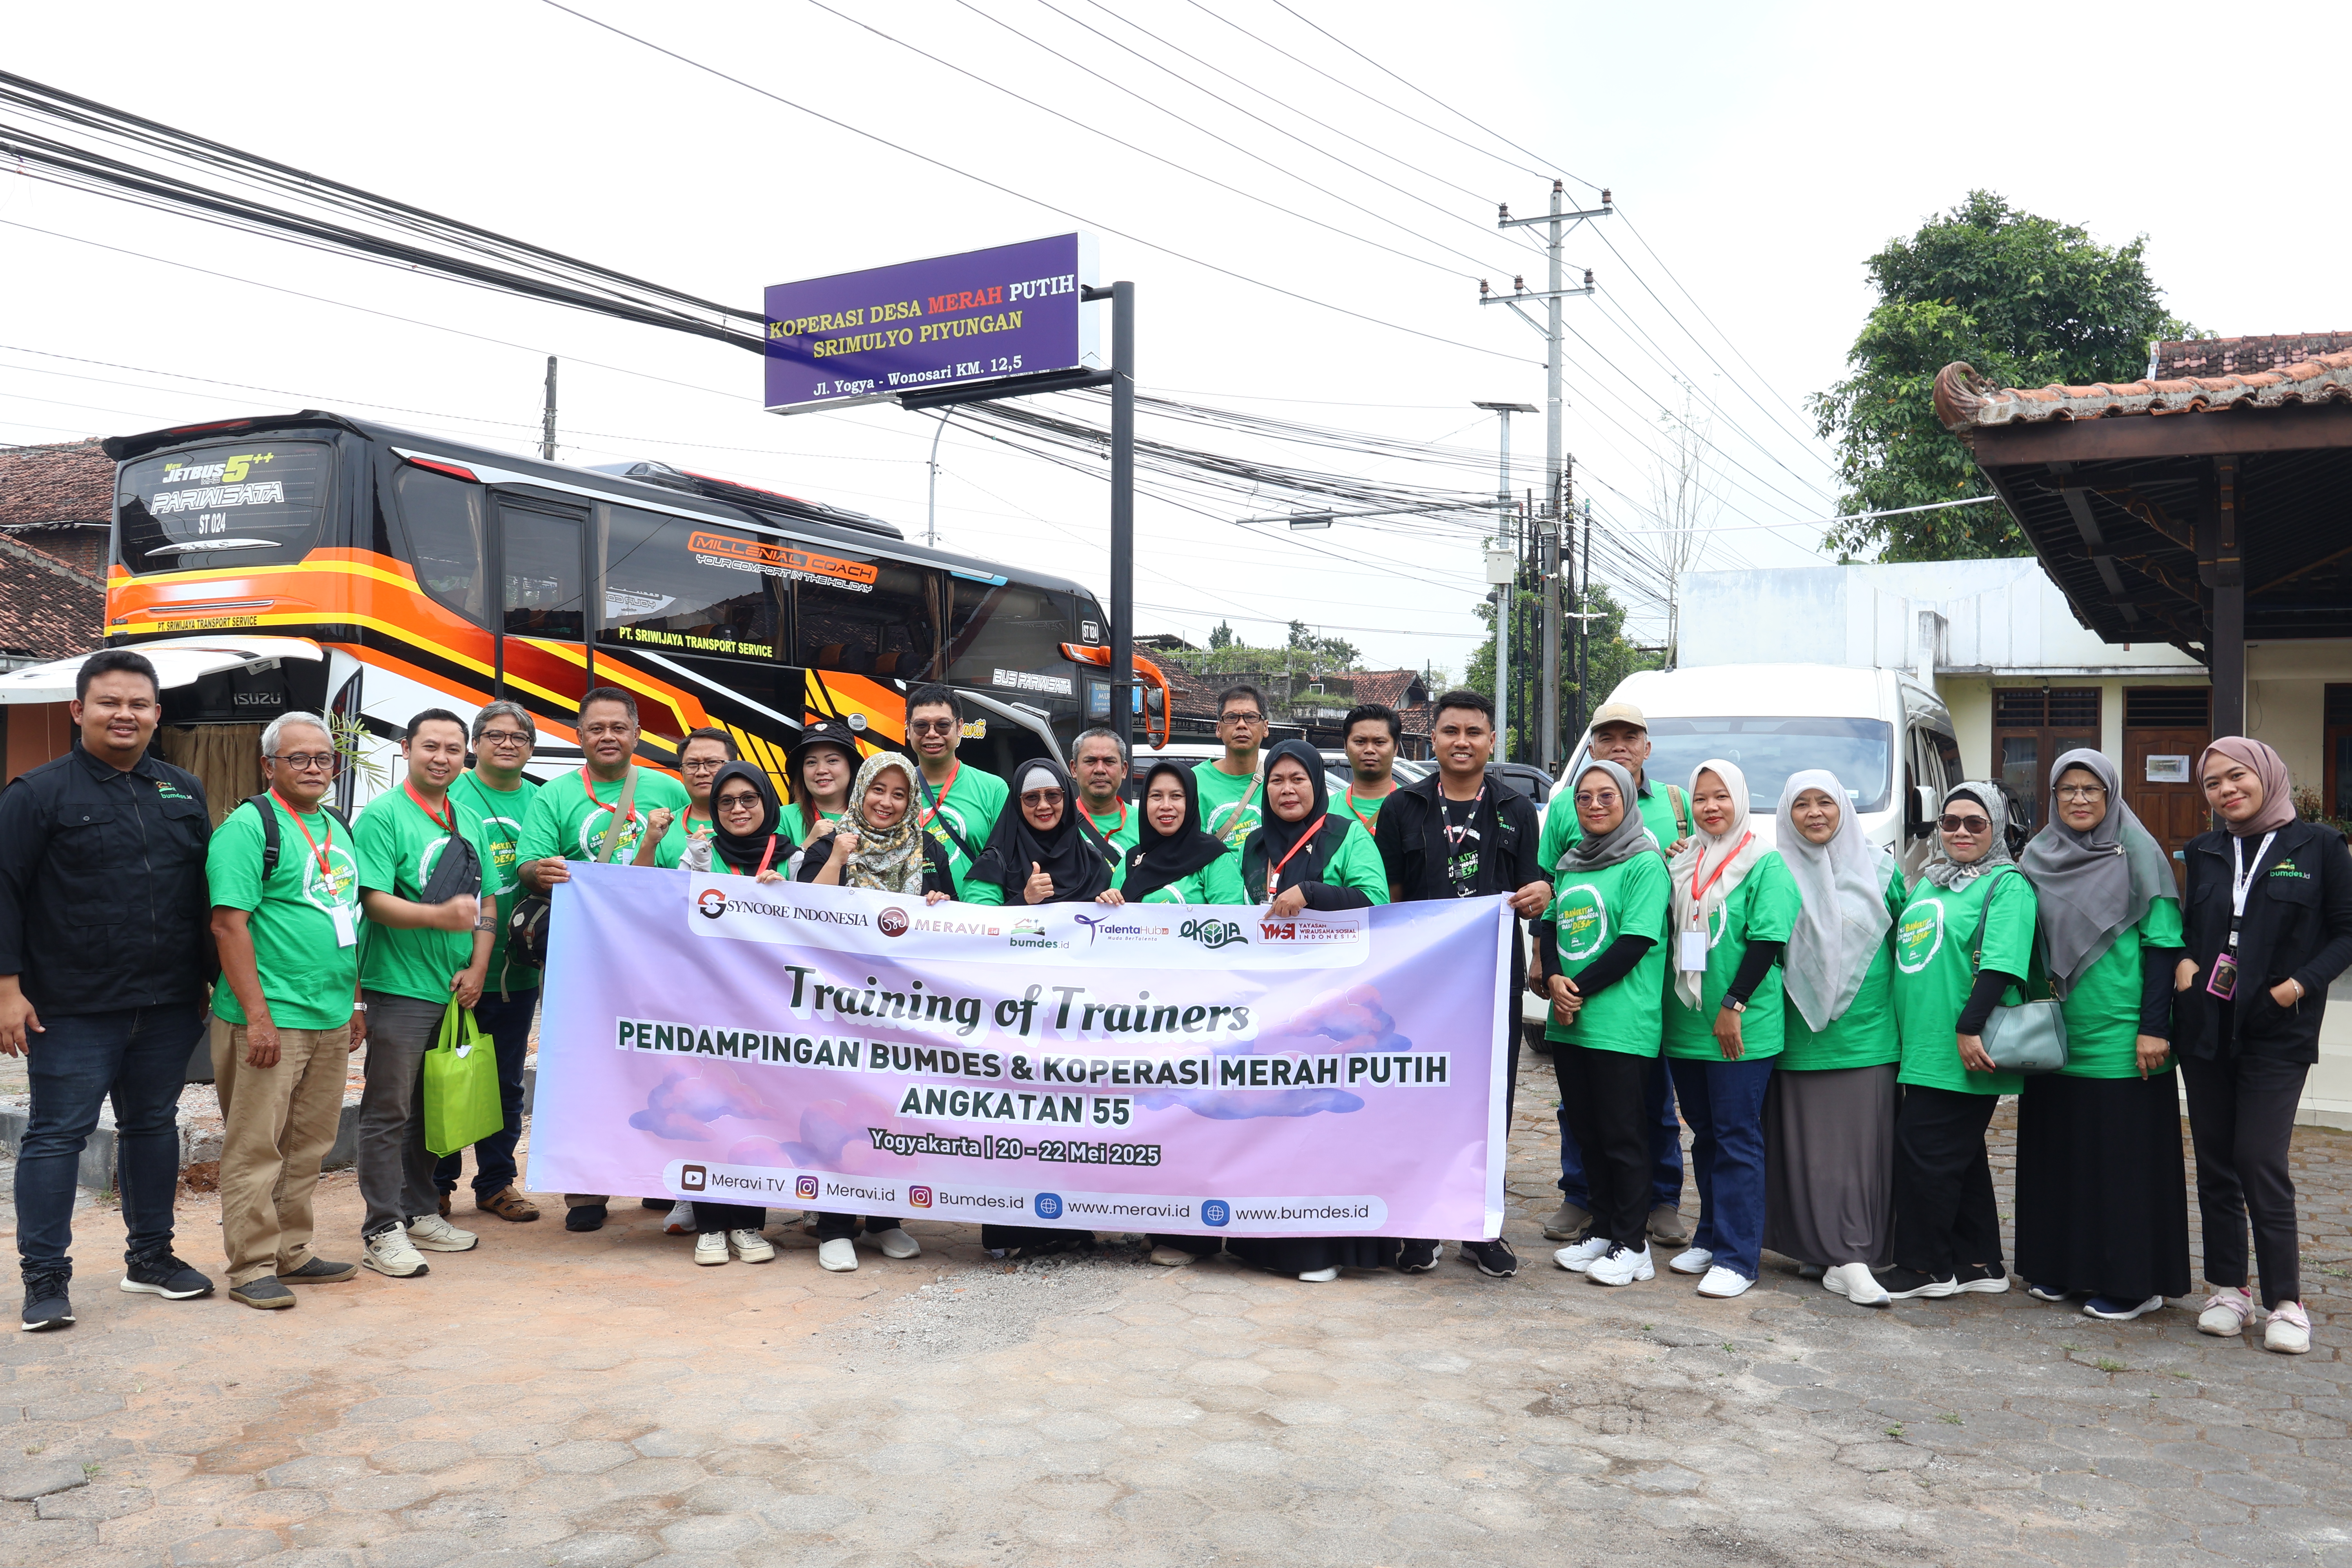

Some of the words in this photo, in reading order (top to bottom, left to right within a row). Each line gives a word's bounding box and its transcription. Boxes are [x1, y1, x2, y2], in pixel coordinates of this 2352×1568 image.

[769, 309, 864, 339] KOPERASI
[871, 300, 922, 323] DESA
[927, 286, 1002, 314] MERAH
[1009, 274, 1074, 301] PUTIH
[813, 328, 913, 358] SRIMULYO
[920, 311, 1022, 342] PIYUNGAN
[813, 382, 829, 396] Jl.
[834, 379, 874, 394] Yogya
[888, 365, 952, 385] Wonosari
[956, 361, 984, 377] KM.
[991, 355, 1022, 372] 12,5
[165, 463, 182, 472] New
[201, 477, 220, 485] MHD
[150, 481, 285, 515] PARIWISATA
[199, 514, 210, 534] ST
[211, 512, 226, 534] 024
[696, 537, 802, 564] MILLENIAL
[811, 558, 872, 579] COACH
[696, 554, 732, 569] YOUR
[791, 570, 803, 581] IN
[804, 573, 828, 586] THE
[828, 578, 873, 593] HOLIDAY
[167, 620, 195, 631] SRIWIJAYA
[197, 618, 230, 629] TRANSPORT
[232, 616, 257, 626] SERVICE
[1083, 625, 1089, 638] ST
[619, 626, 633, 640] PT.
[635, 628, 683, 647] SRIWIJAYA
[685, 635, 736, 653] TRANSPORT
[738, 642, 773, 658] SERVICE
[993, 668, 1018, 687] BUS
[1018, 672, 1072, 694] PARIWISATA
[234, 692, 281, 704] ISUZU
[2259, 835, 2271, 856] SYNCORE
[2270, 871, 2310, 879] bumdes.id
[727, 900, 789, 918] SYNCORE
[793, 907, 869, 926] INDONESIA
[1577, 912, 1599, 921] INDONESIA
[1259, 923, 1295, 940] YWSI
[1572, 919, 1596, 930] DESA
[1010, 937, 1069, 949] bumdes.id
[784, 964, 980, 1036] Training
[993, 984, 1042, 1037] of
[1051, 985, 1250, 1033] Trainers
[619, 1020, 860, 1068] PENDAMPINGAN
[871, 1044, 1002, 1078] BUMDES
[1011, 1055, 1033, 1080] &
[1044, 1057, 1210, 1085] KOPERASI
[1221, 1058, 1337, 1086] MERAH
[1348, 1056, 1446, 1083] PUTIH
[900, 1088, 1082, 1123] ANGKATAN
[1093, 1098, 1130, 1125] 55
[871, 1131, 980, 1154] Yogyakarta
[996, 1140, 1020, 1158] 20
[1041, 1142, 1065, 1160] 22
[1071, 1144, 1106, 1162] Mei
[1111, 1145, 1159, 1164] 2025
[712, 1174, 762, 1190] Meravi
[767, 1179, 785, 1192] TV
[827, 1183, 895, 1202] Meravi.id
[940, 1192, 1024, 1210] Bumdes.id
[1068, 1201, 1190, 1218] www.meravi.id
[1236, 1205, 1368, 1221] www.bumdes.id
